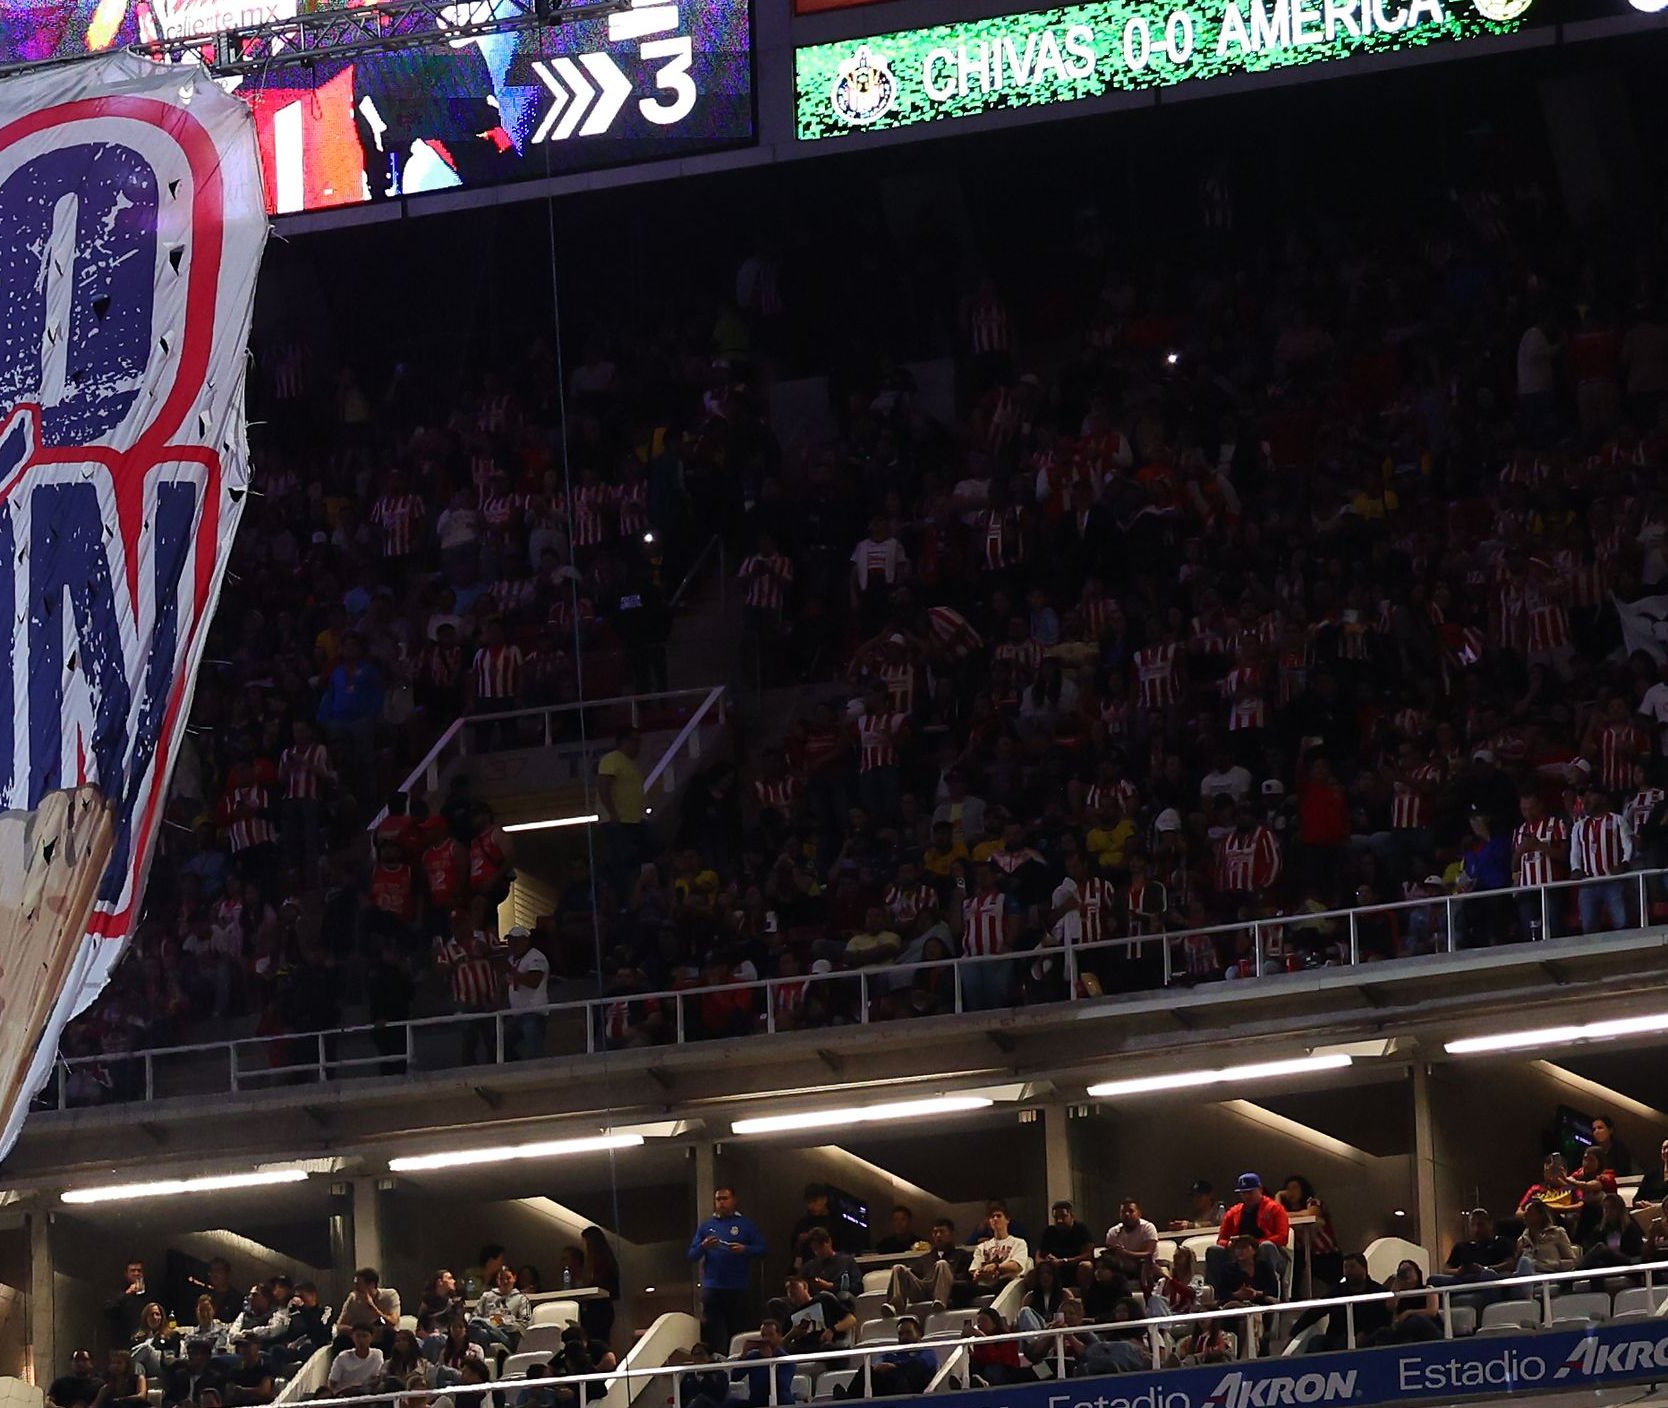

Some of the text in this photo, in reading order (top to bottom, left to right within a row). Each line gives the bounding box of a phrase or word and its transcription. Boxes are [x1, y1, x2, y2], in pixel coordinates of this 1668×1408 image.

[639, 36, 697, 125] 3
[921, 27, 1096, 102] CHIVAS
[1123, 14, 1194, 69] 0-0
[1399, 1350, 1545, 1391] Estadio
